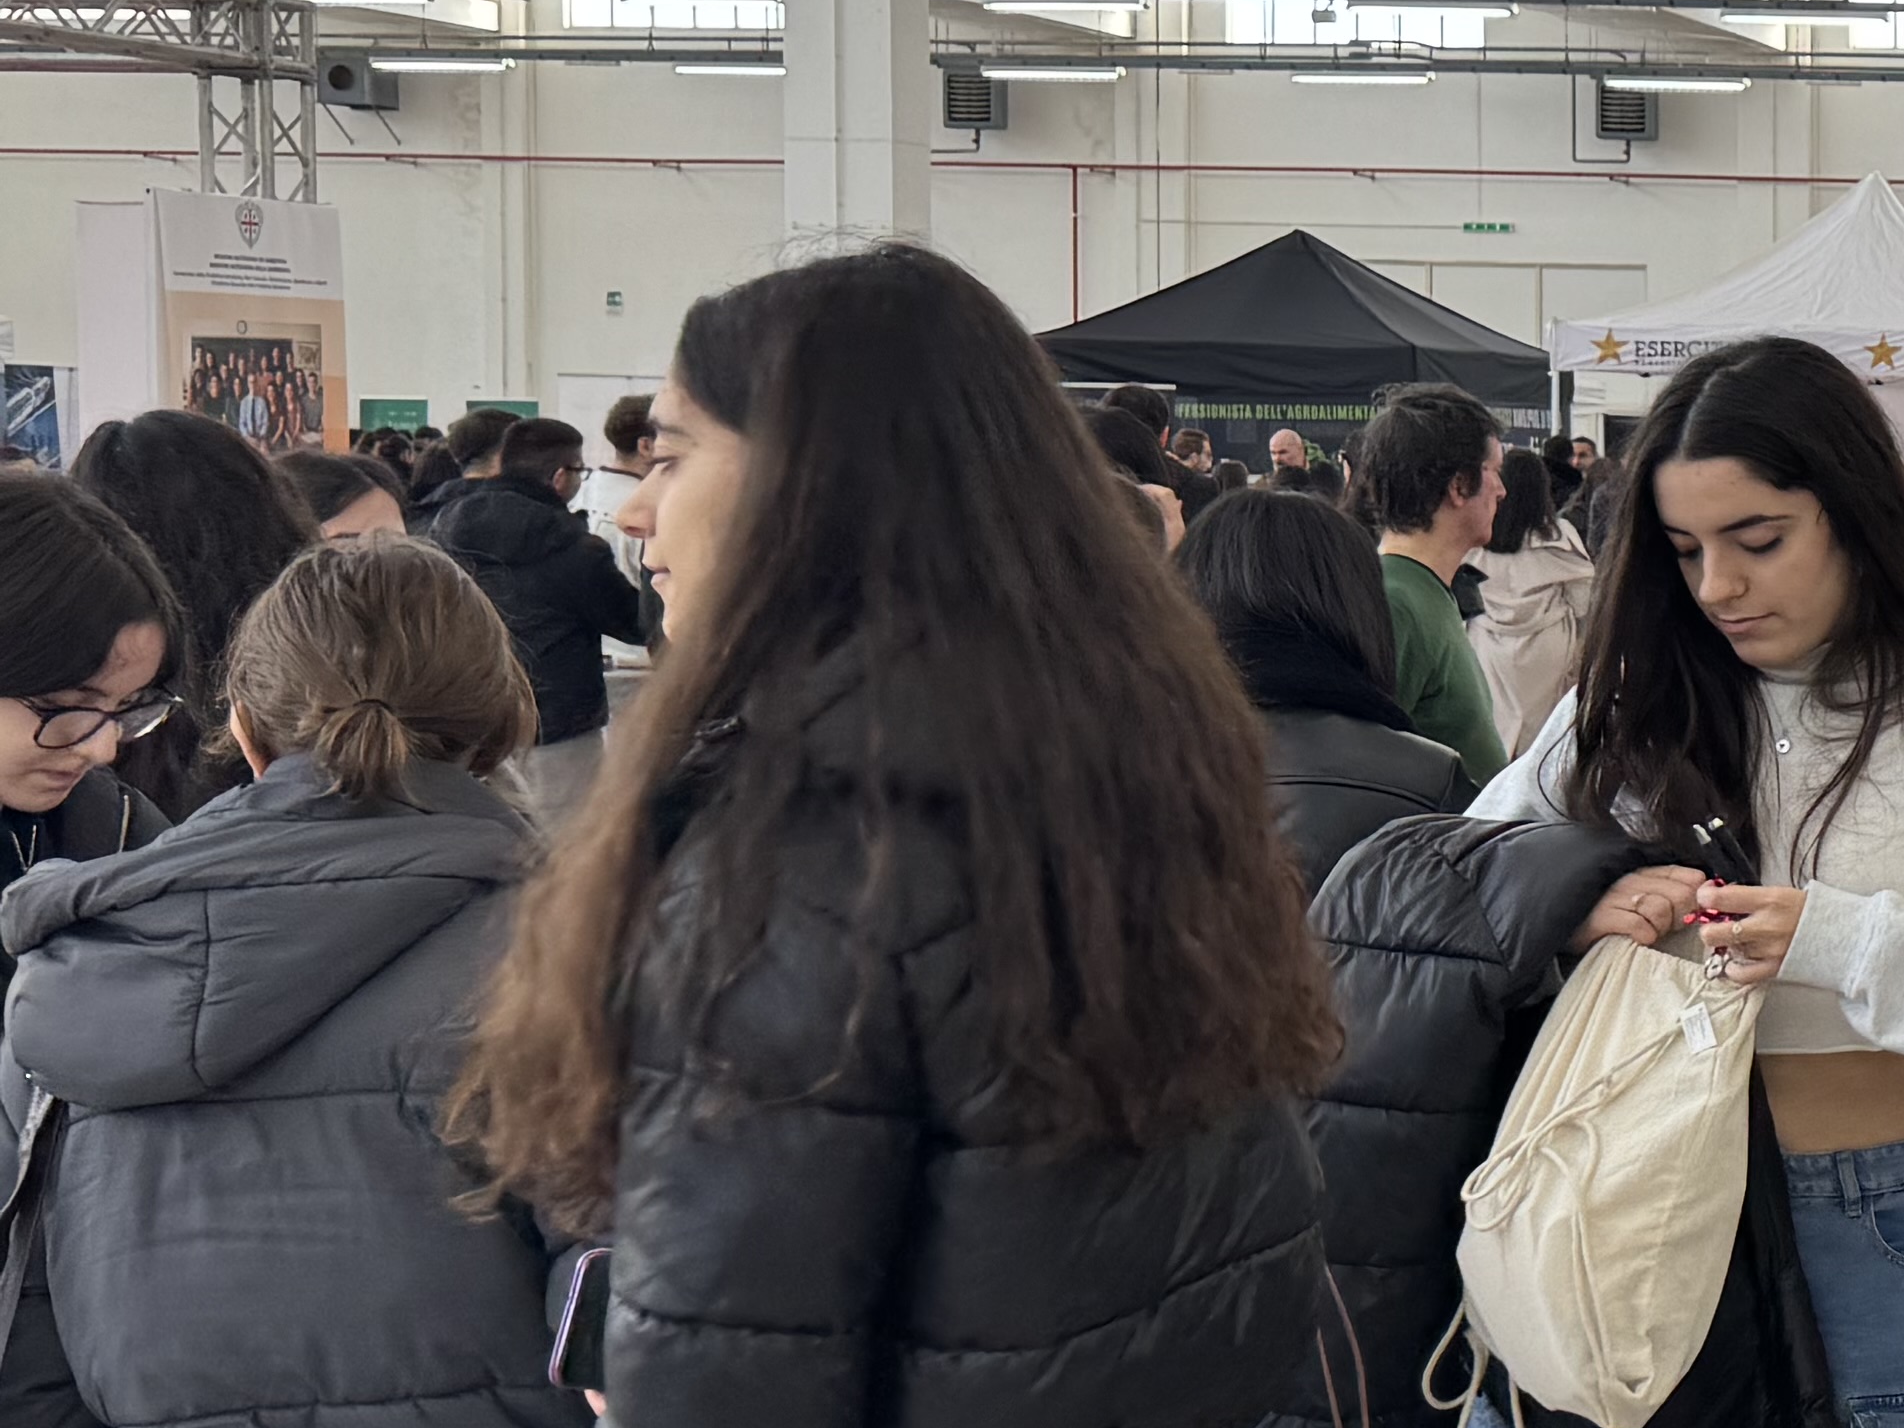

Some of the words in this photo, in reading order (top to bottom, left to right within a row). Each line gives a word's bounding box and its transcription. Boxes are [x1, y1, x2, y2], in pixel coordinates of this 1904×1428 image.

[1634, 340, 1723, 358] ESERCI
[1175, 403, 1253, 419] FESSIONISTA
[1255, 404, 1378, 421] DELL'AGROALIMENTA
